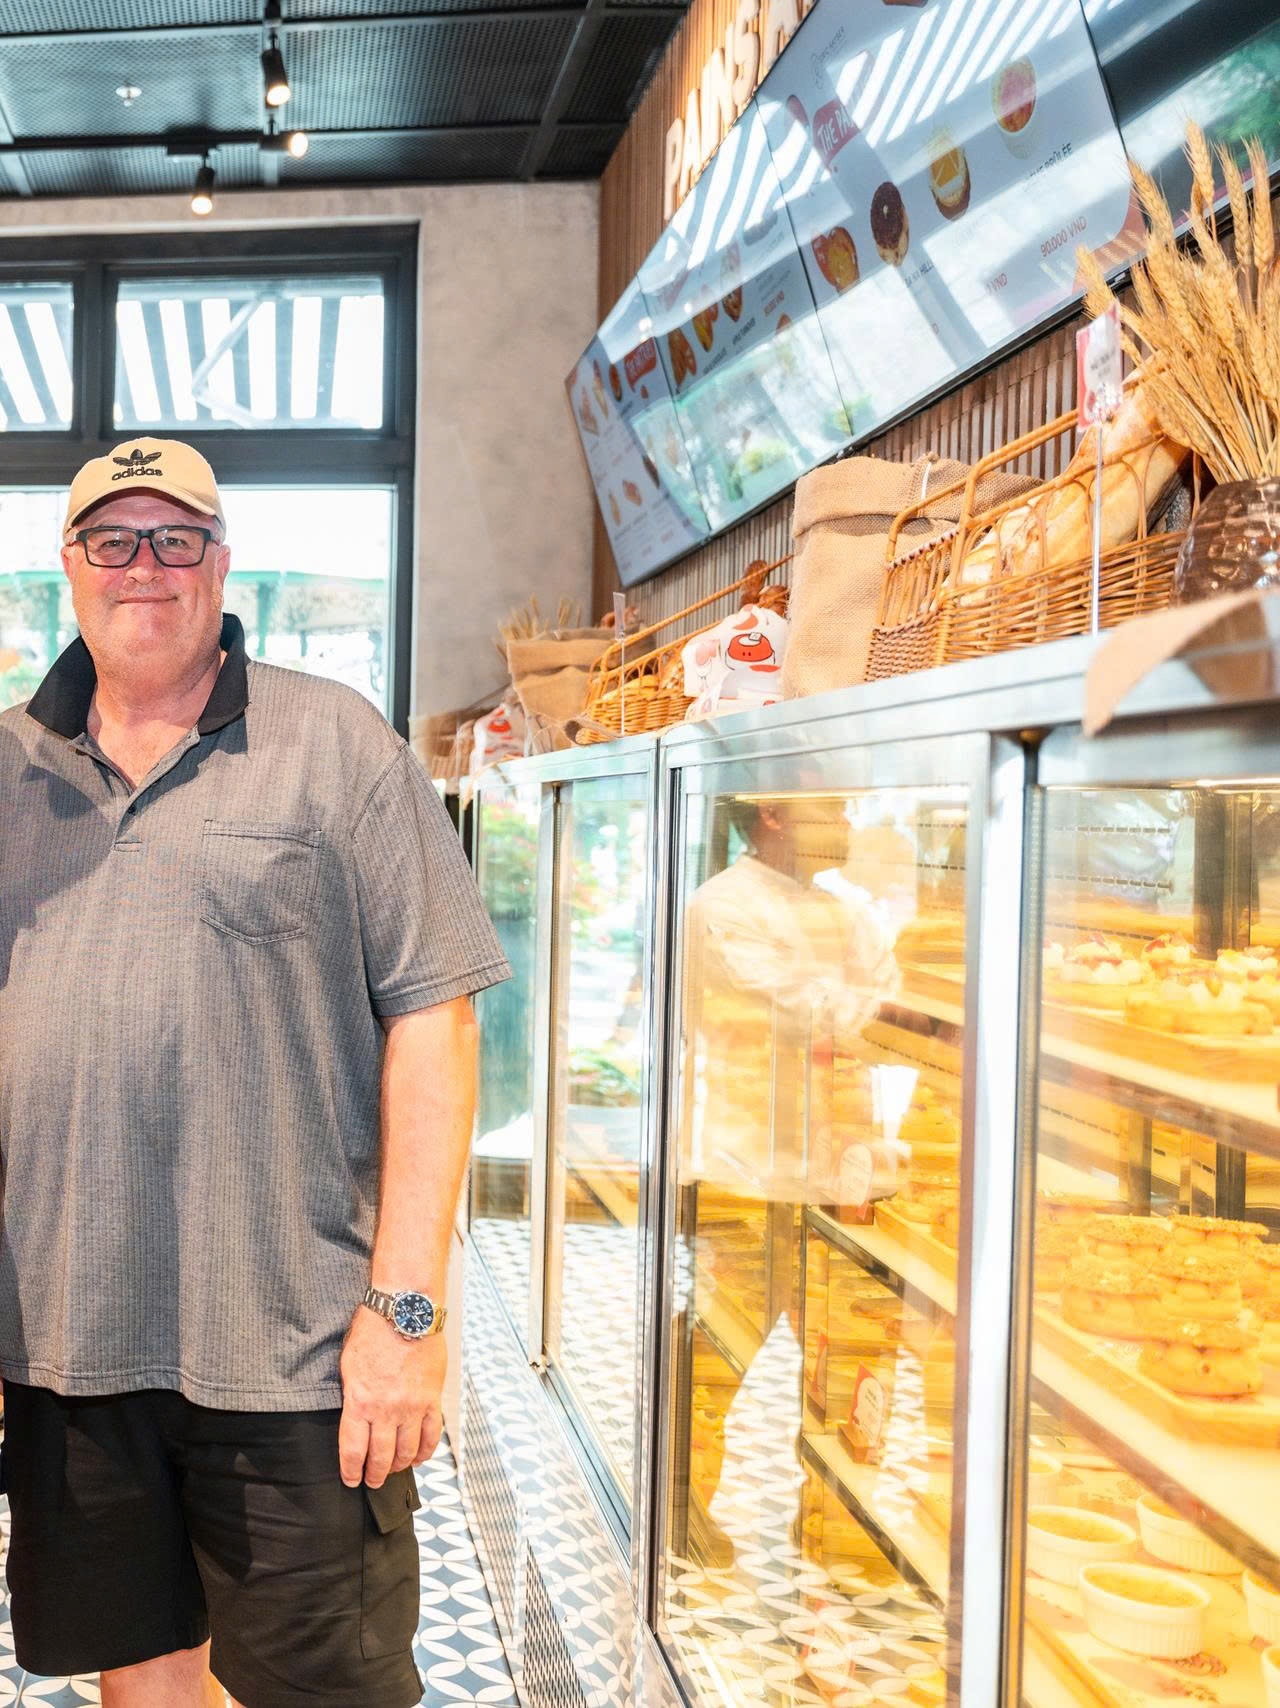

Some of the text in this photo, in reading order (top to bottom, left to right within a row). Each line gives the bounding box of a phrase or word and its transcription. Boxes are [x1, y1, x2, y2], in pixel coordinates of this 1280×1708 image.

[817, 118, 839, 155] THE
[1066, 216, 1088, 238] VND
[111, 466, 163, 481] adidas
